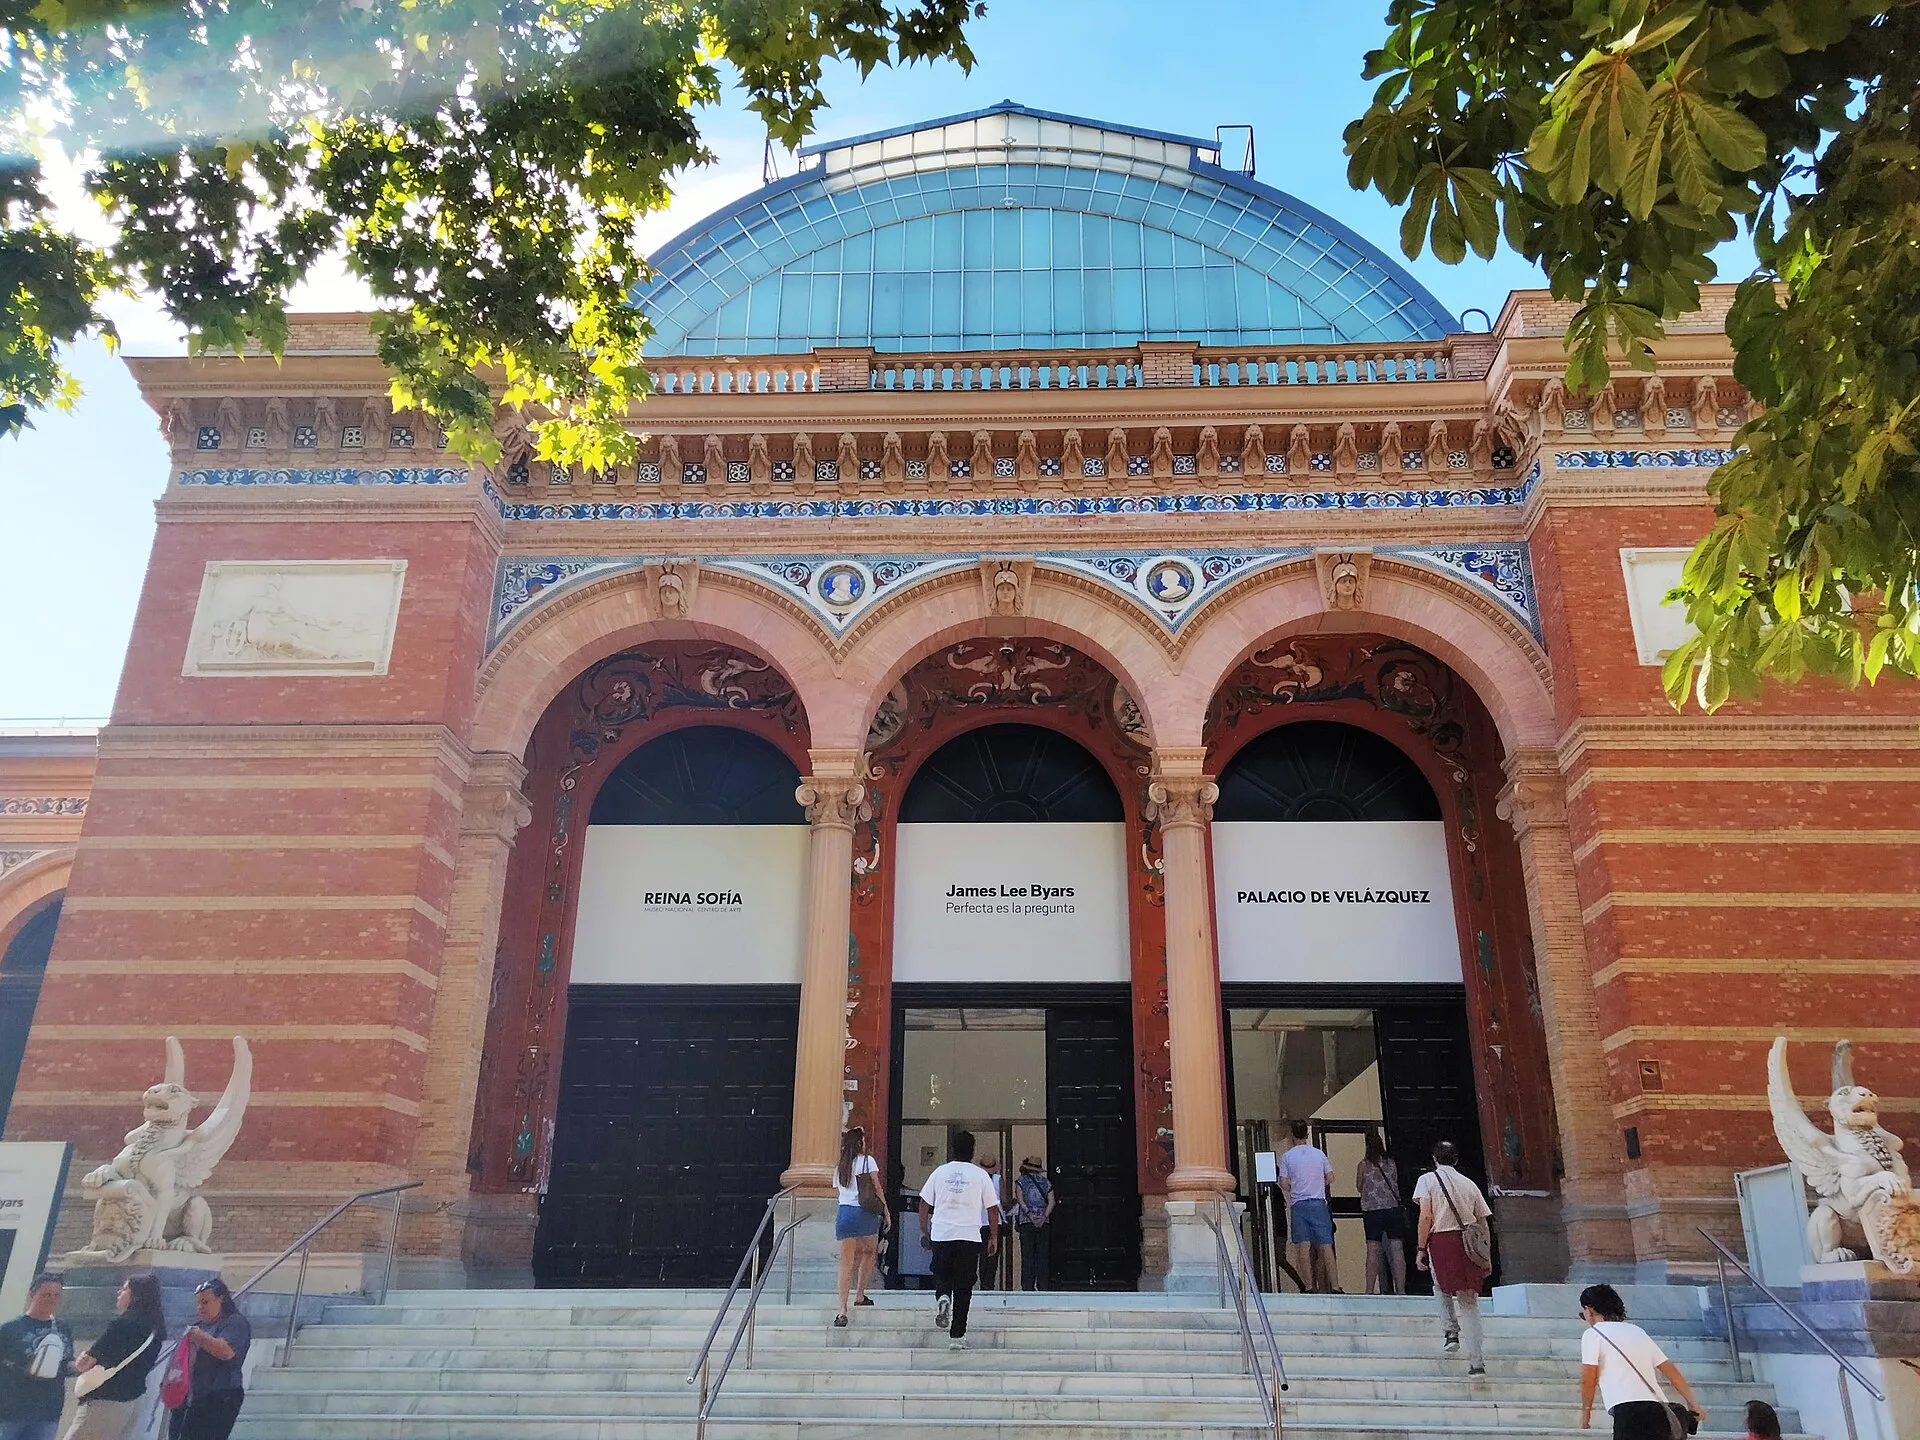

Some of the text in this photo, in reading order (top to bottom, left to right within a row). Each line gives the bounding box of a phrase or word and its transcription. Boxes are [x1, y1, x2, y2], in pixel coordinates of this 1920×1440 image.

[645, 890, 742, 904] REINA SOFÍA
[946, 884, 1075, 900] James Lee Byars
[1237, 887, 1430, 903] PALACIO DE VELÁZQUEZ
[946, 902, 1075, 916] Perfecta es la pregunta
